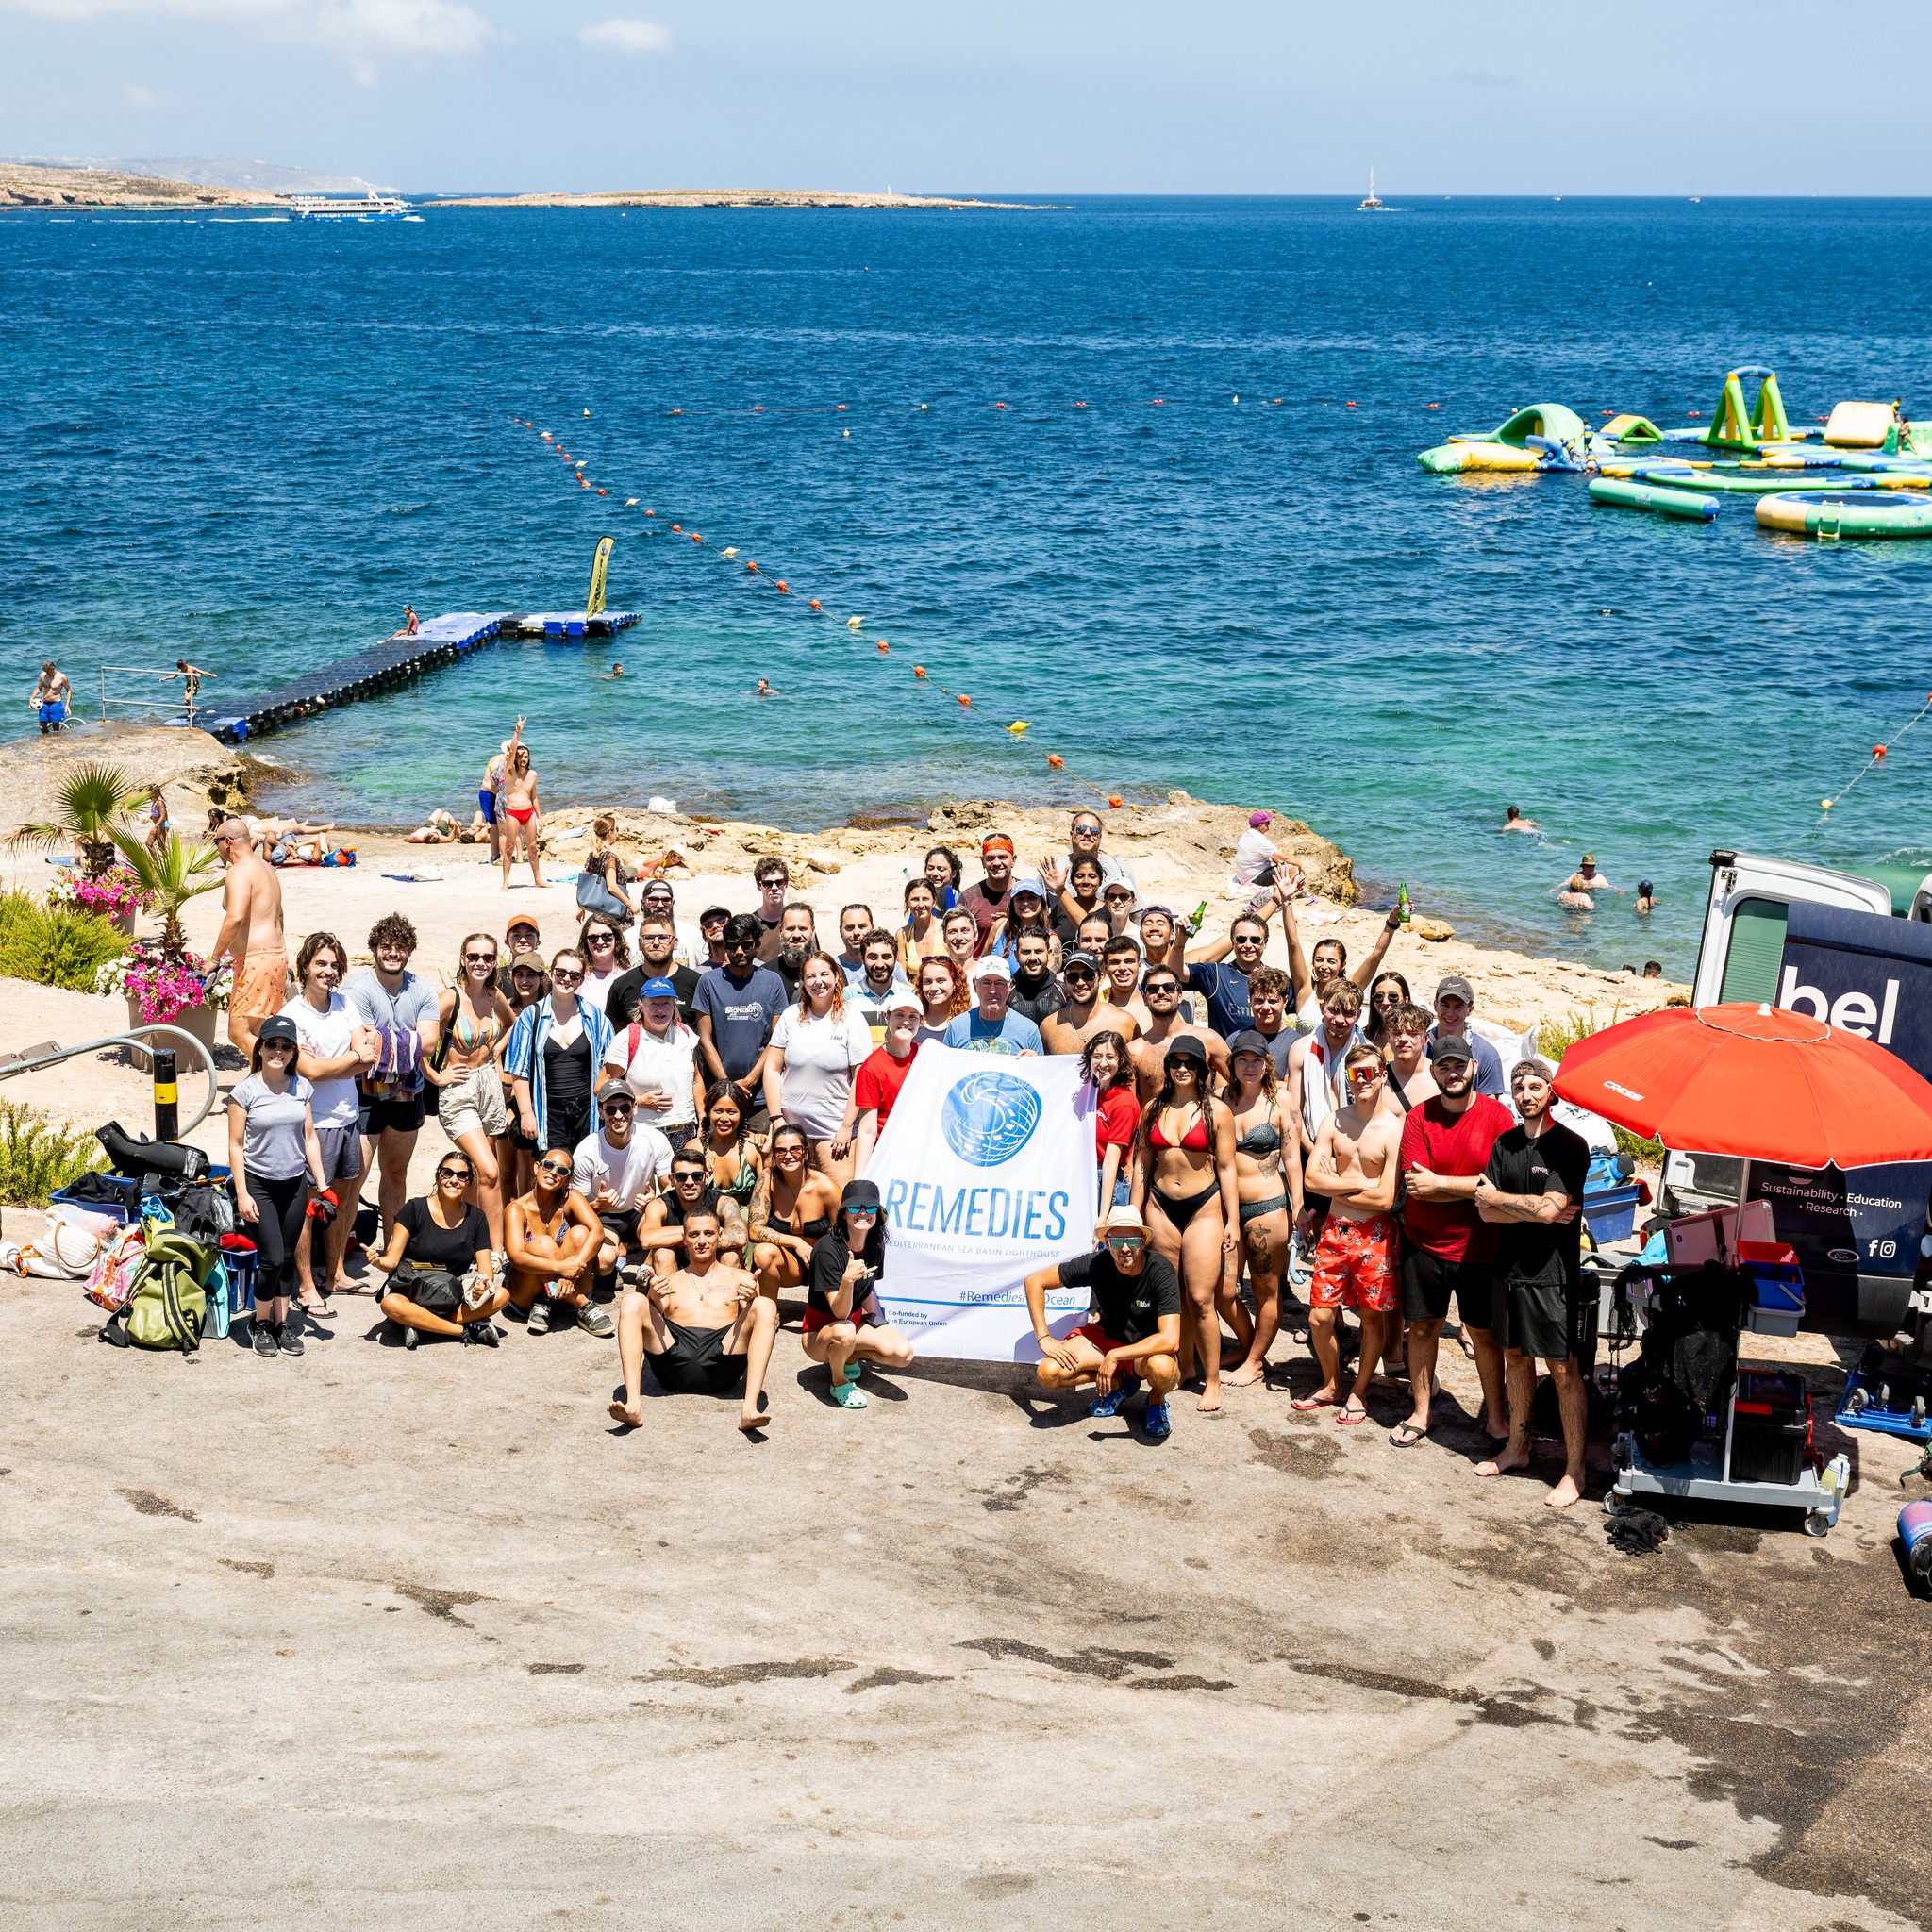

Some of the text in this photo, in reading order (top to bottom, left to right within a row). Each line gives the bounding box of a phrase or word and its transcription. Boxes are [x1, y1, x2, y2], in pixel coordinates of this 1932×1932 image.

[1603, 1080, 1645, 1102] CRESSI
[1761, 1182, 1902, 1209] Sustainability Education
[885, 1178, 1069, 1241] REMEDIES
[1806, 1201, 1857, 1217] Research
[957, 1245, 974, 1254] SEA
[975, 1247, 1002, 1256] BASIN
[1005, 1249, 1060, 1258] LIGHTHOUSE
[888, 1309, 920, 1318] Co-funded
[898, 1318, 927, 1326] European
